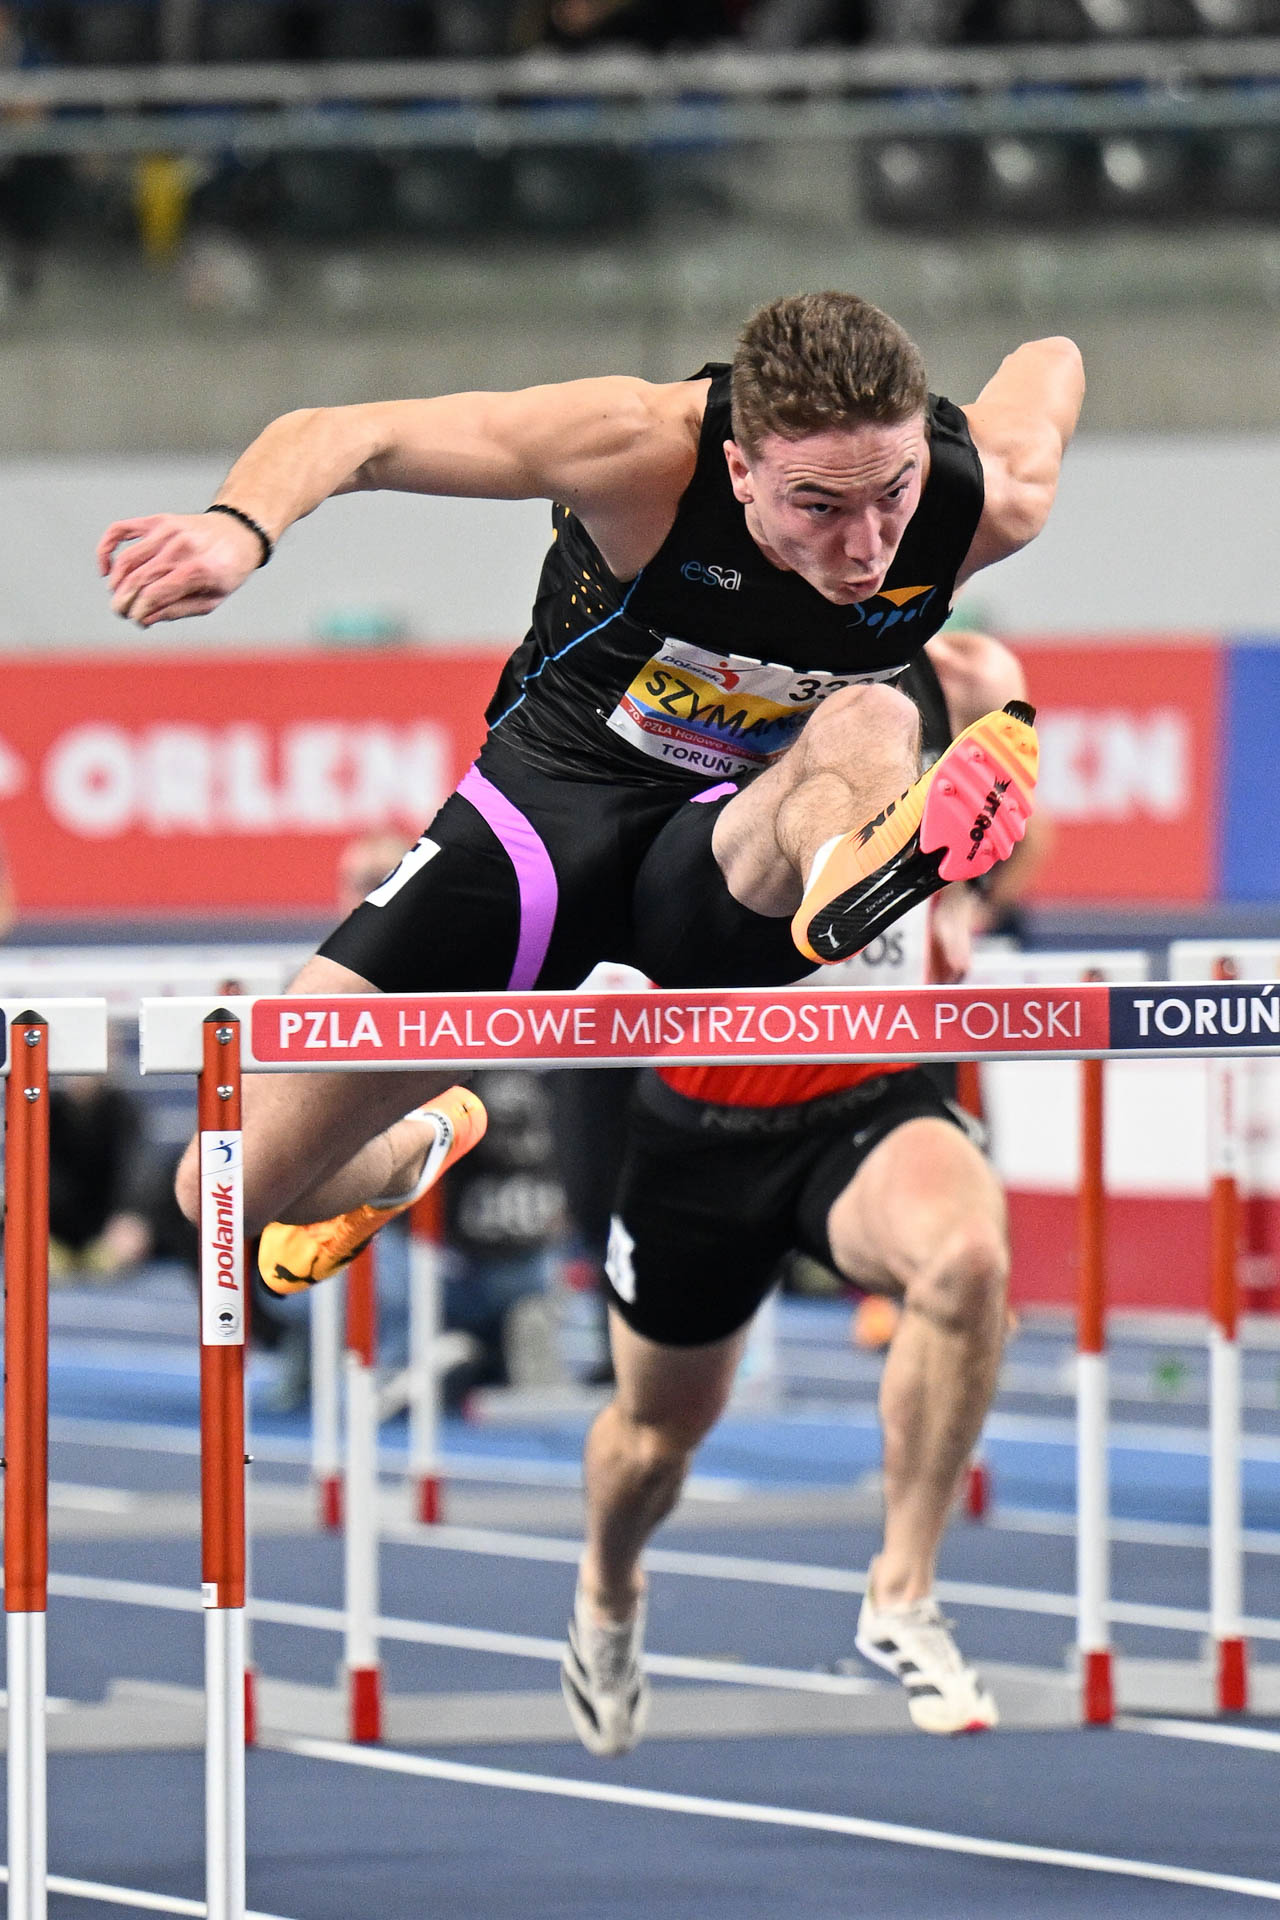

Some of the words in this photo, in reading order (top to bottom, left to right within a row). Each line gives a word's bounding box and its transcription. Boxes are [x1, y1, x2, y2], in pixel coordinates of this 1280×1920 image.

[788, 677, 875, 702] 33
[643, 719, 673, 736] PZLA
[42, 720, 446, 838] ORLEN
[662, 743, 733, 774] TORUŃ
[279, 1011, 383, 1048] PZLA
[399, 1008, 596, 1047] HALOWE
[610, 1003, 920, 1044] MISTRZOSTWA
[935, 1001, 1082, 1040] POLSKI
[1133, 985, 1280, 1036] TORUŃ
[210, 1183, 240, 1291] polanik
